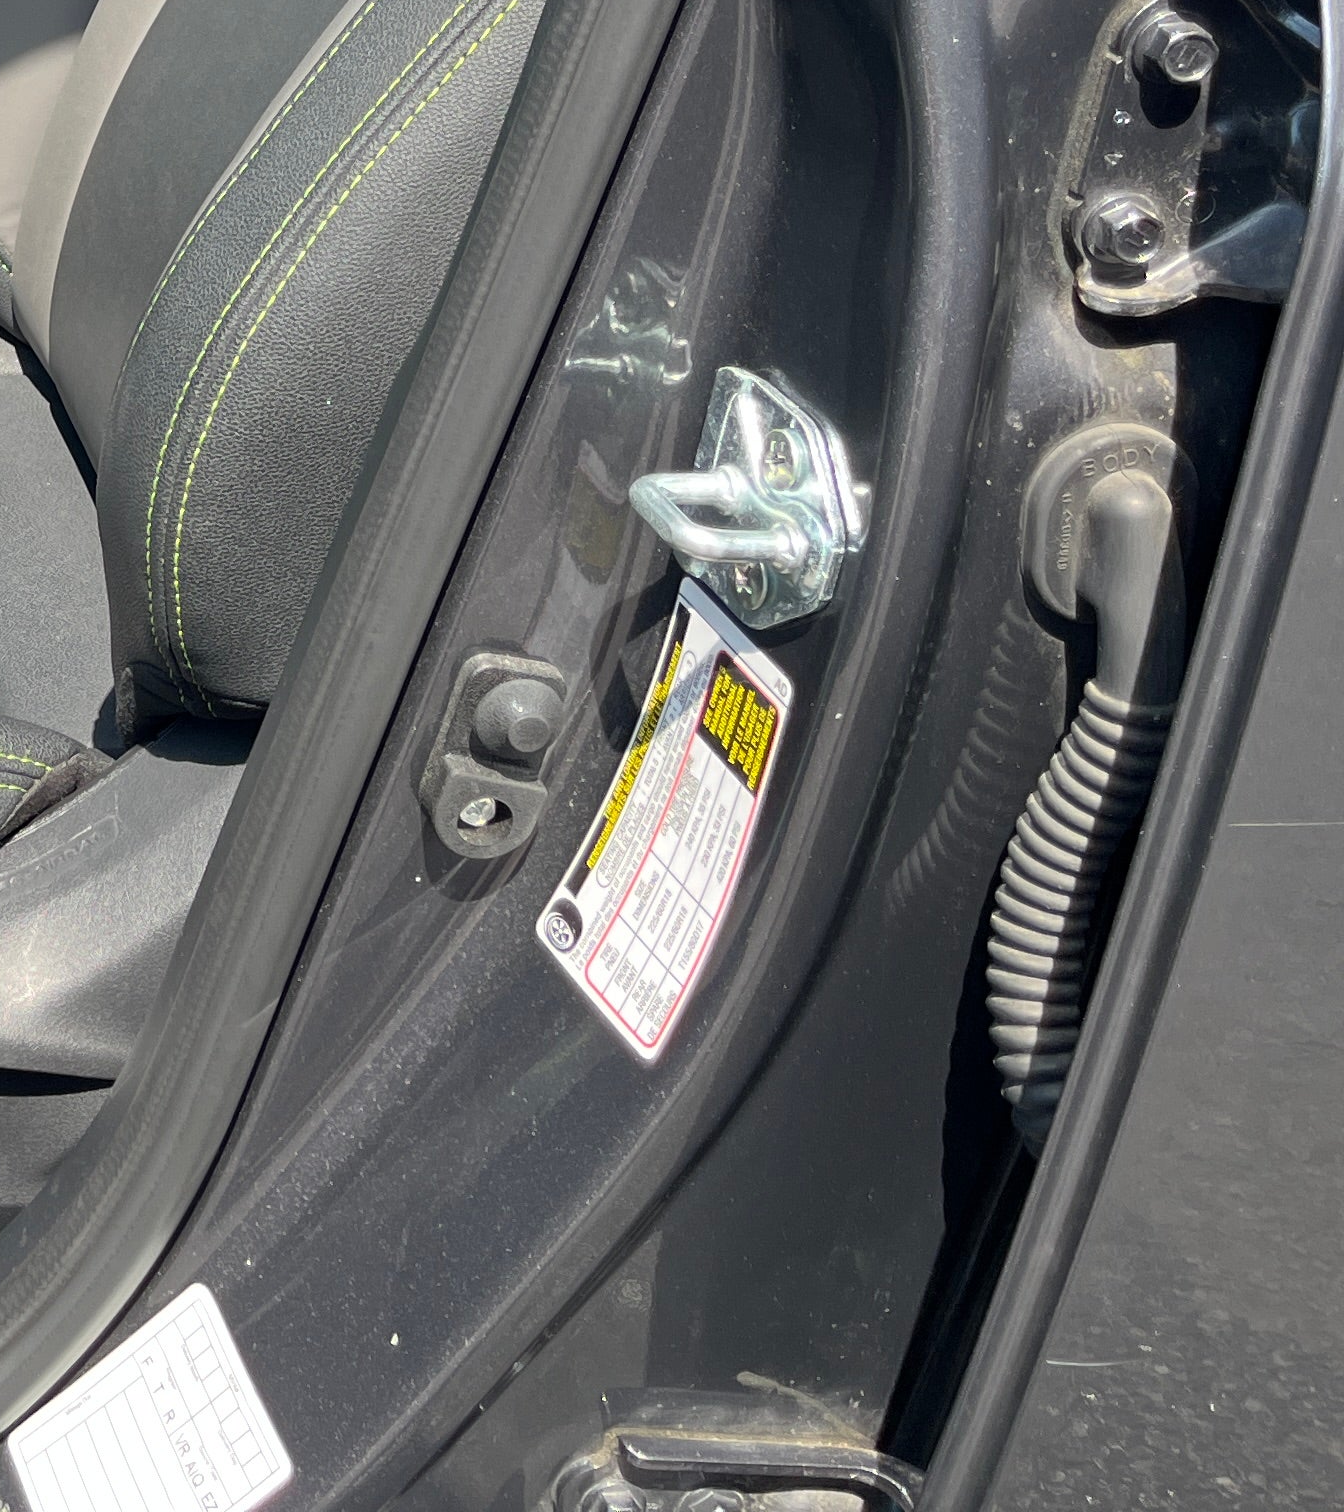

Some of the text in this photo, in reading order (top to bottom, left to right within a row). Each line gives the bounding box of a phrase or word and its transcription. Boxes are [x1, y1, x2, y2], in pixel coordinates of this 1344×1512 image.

[1081, 443, 1161, 478] BODY
[701, 707, 714, 727] SEE
[708, 673, 732, 735] MANUAL FOR
[716, 683, 738, 739] ADDITIONAL
[721, 683, 746, 750] INFORMATION
[727, 689, 756, 764] VOIR LE MANUEL
[737, 748, 746, 764] DE
[742, 706, 767, 775] POUR PLUS DE
[140, 1355, 177, 1424] F T R
